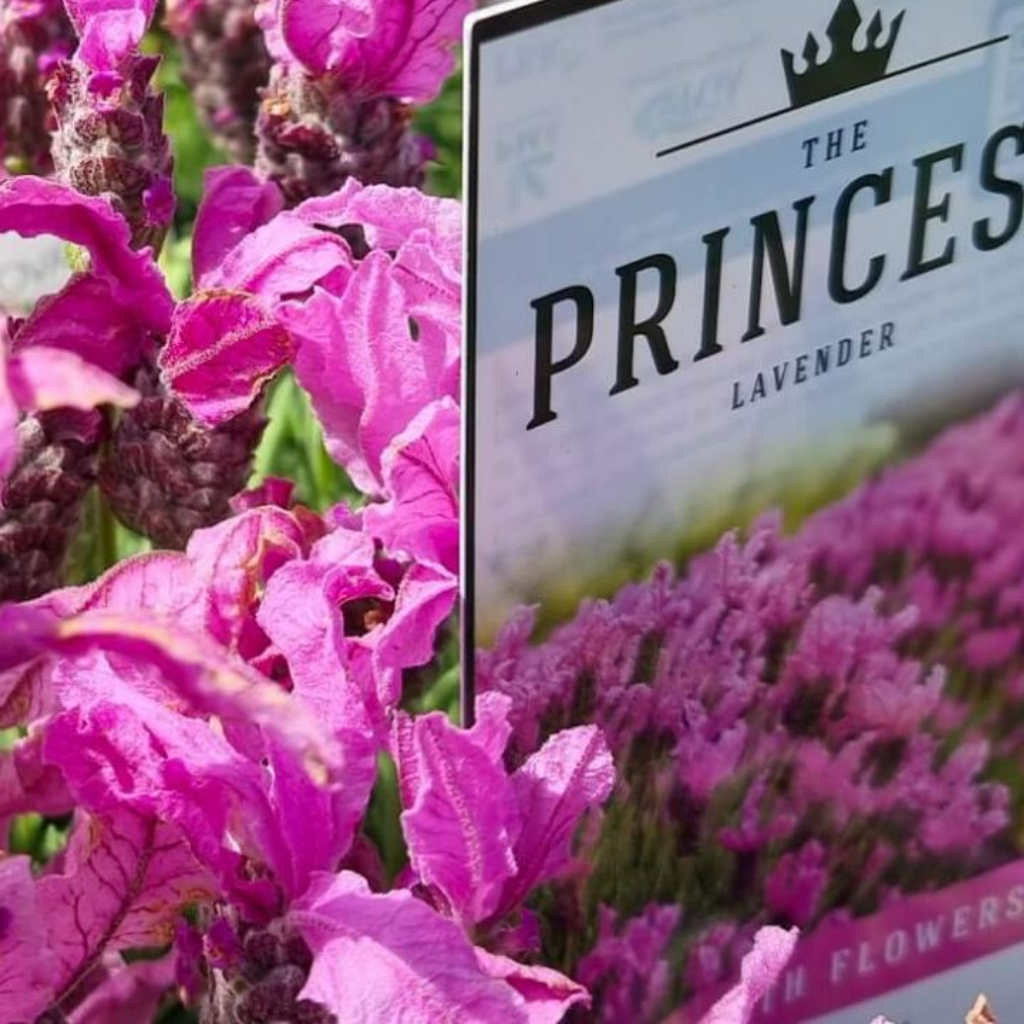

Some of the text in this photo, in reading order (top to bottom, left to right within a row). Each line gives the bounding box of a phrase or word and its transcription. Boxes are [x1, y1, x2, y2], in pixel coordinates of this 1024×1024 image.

[801, 119, 869, 169] THE
[526, 123, 1024, 430] PRINCES
[731, 321, 896, 410] LAVENDER
[831, 886, 1024, 985] FLOWERS
